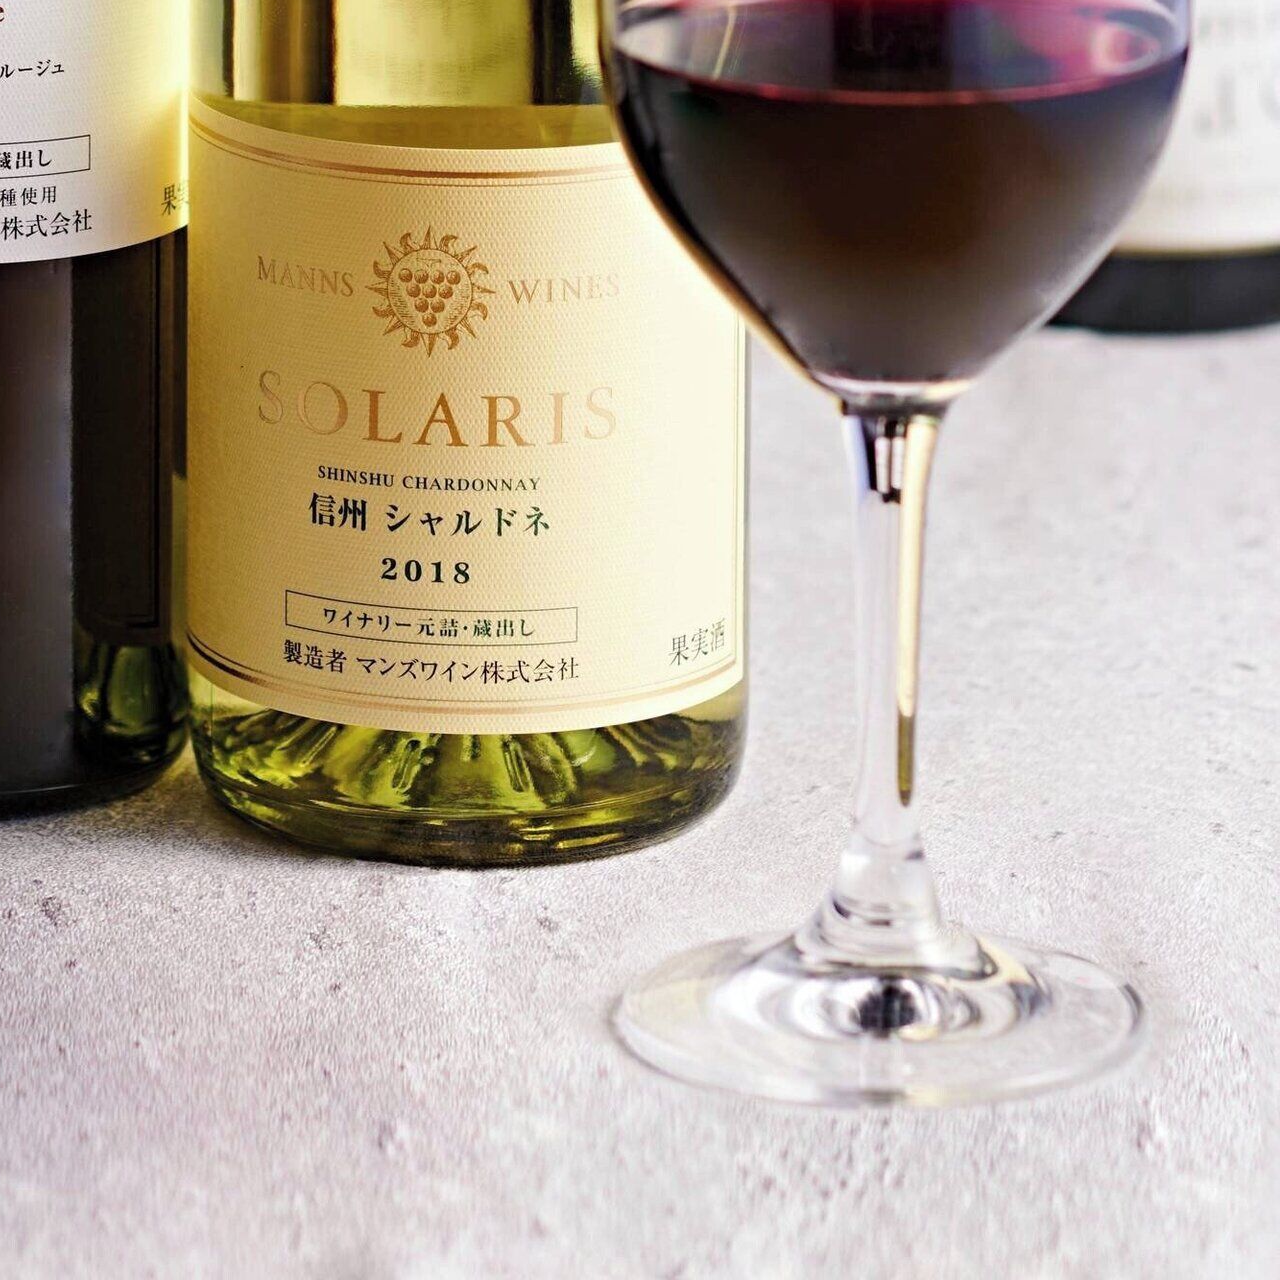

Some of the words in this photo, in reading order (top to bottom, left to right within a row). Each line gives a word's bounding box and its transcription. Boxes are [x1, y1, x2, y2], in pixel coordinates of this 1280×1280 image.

[257, 255, 354, 298] MANNS
[508, 271, 621, 305] WINES
[258, 369, 618, 448] SOLARIS
[317, 464, 395, 489] SHINSHU
[402, 475, 541, 493] CHARDONNAY
[308, 491, 368, 533] 信州
[385, 503, 551, 538] シャルドネ
[380, 556, 472, 585] 2018
[323, 607, 536, 639] ワイナリー元詰・蔵出し
[668, 617, 727, 668] 果実酒
[282, 639, 348, 675] 製造者
[355, 657, 580, 686] マンズワイン株式会社
